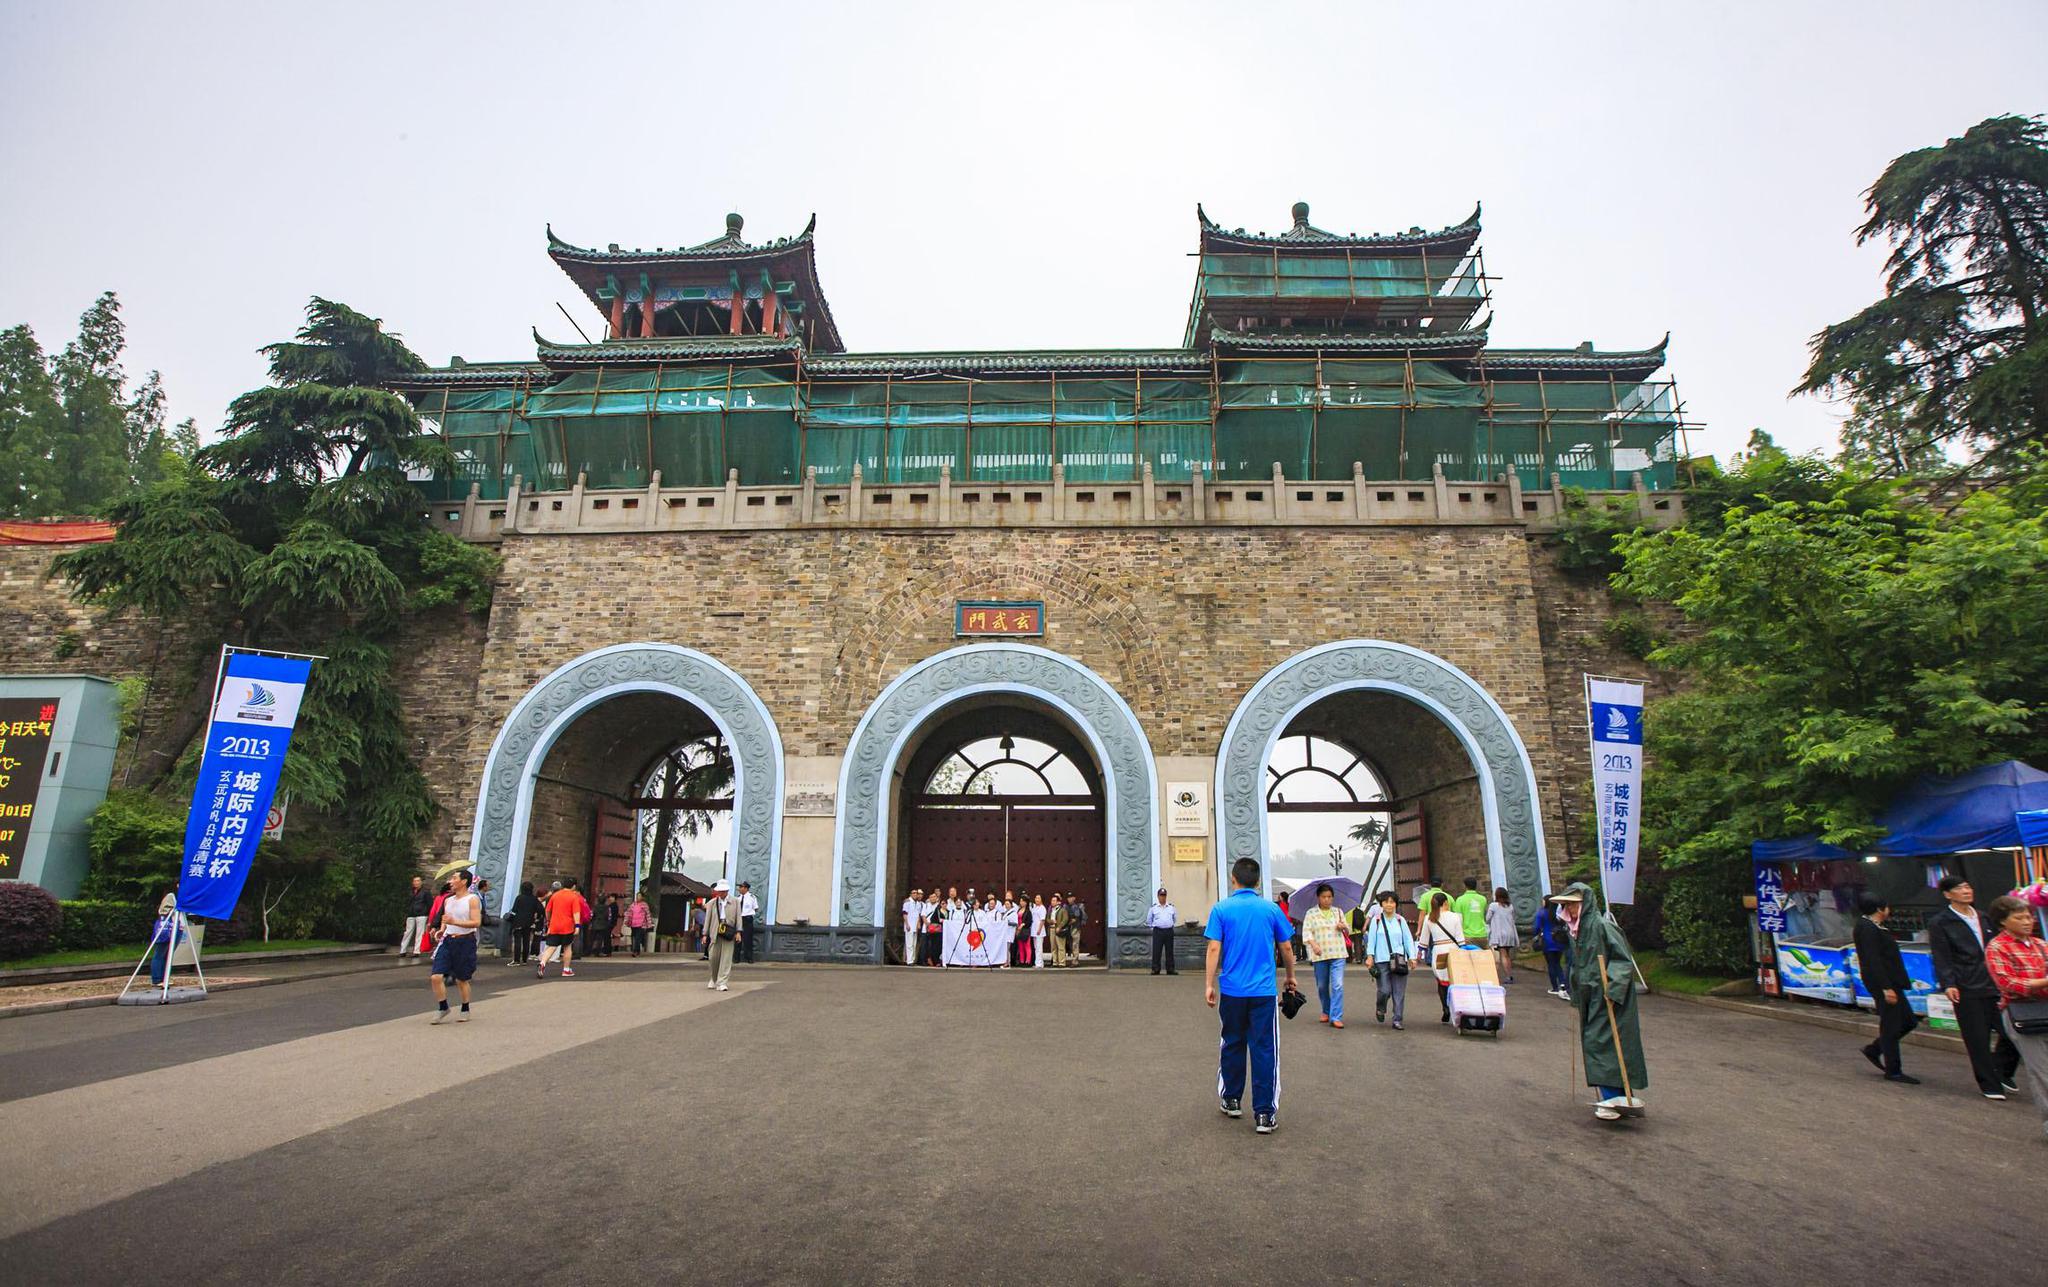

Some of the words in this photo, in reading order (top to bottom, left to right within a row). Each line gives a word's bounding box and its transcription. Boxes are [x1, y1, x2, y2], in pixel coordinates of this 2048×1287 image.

[0, 721, 51, 737] 今日天气
[220, 736, 270, 756] 2013
[1603, 754, 1632, 769] 2013
[209, 770, 261, 878] 城际内湖杯
[1610, 782, 1630, 872] 城际内湖杯
[1758, 868, 1785, 931] 小件寄存
